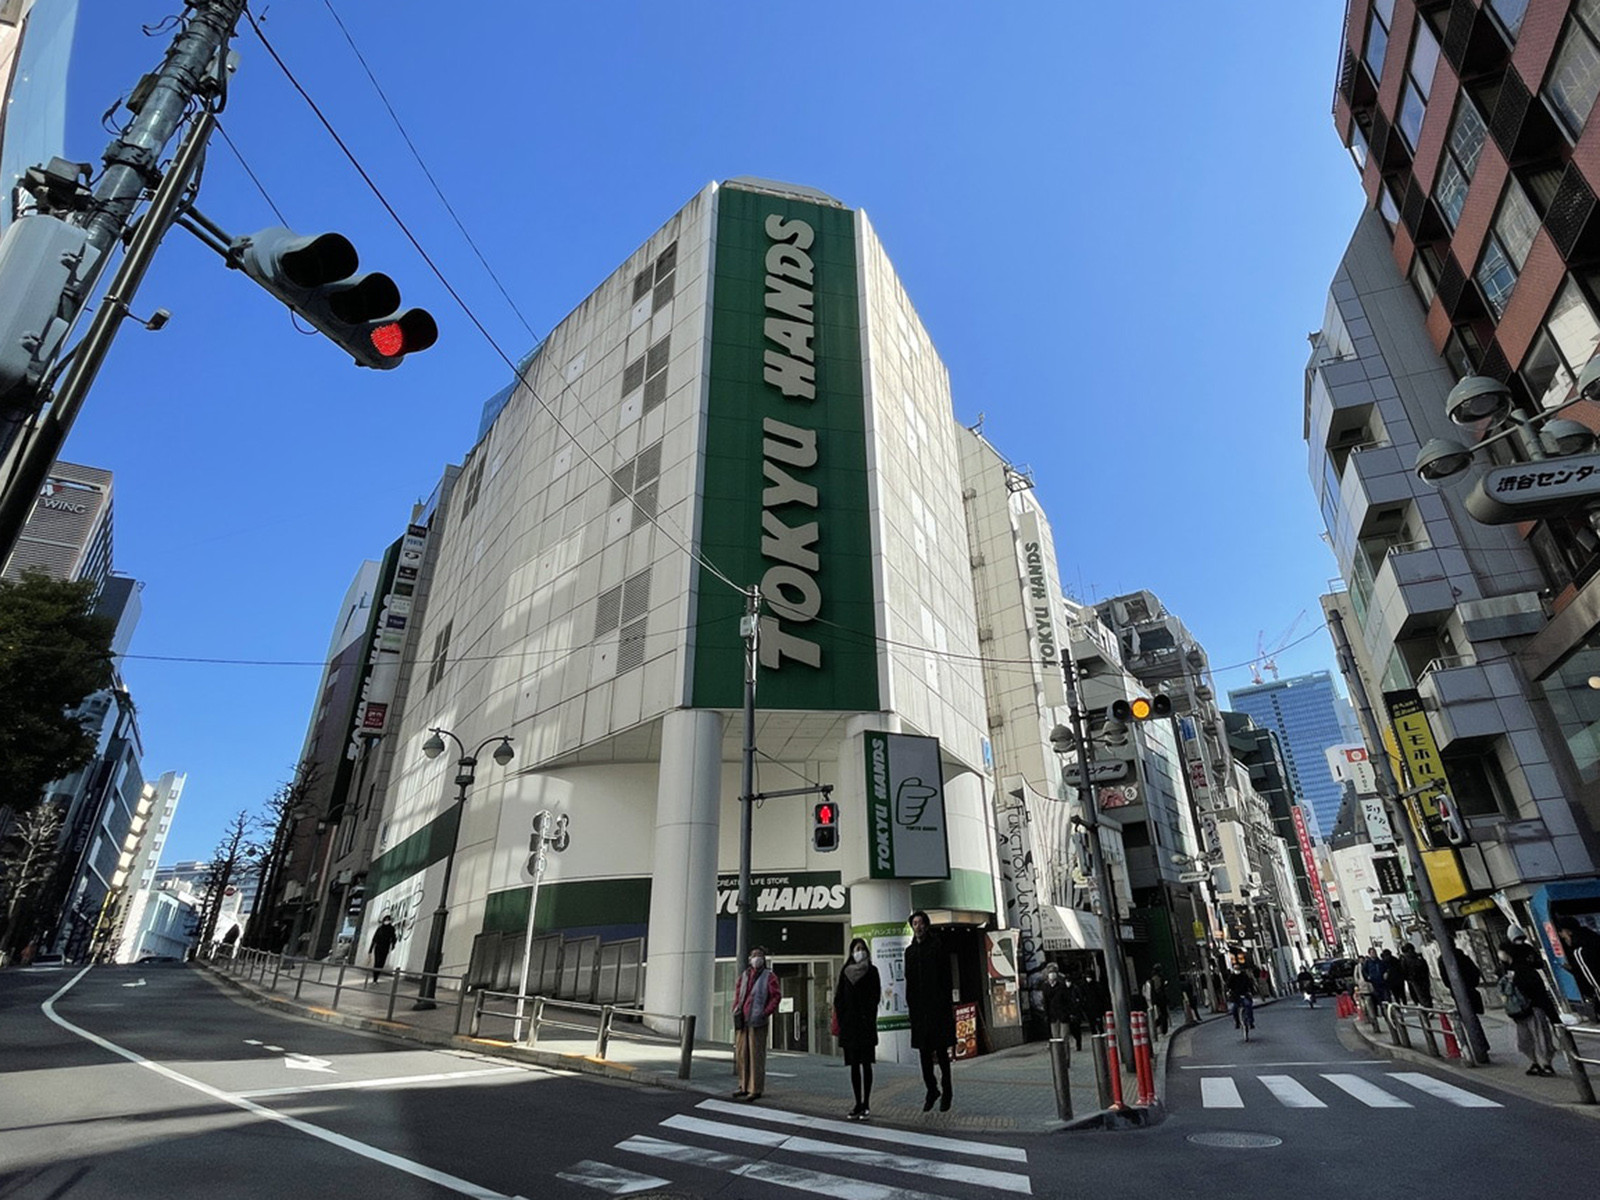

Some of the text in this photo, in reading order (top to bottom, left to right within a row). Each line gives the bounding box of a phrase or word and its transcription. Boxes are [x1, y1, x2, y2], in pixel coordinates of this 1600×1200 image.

[759, 213, 821, 668] TOKYU HANDS
[1025, 541, 1060, 669] TOKYU HANDS
[871, 738, 891, 870] TOKYU HANDS
[756, 884, 846, 912] HANDS
[1006, 804, 1037, 964] FUNCTION JUNCTION
